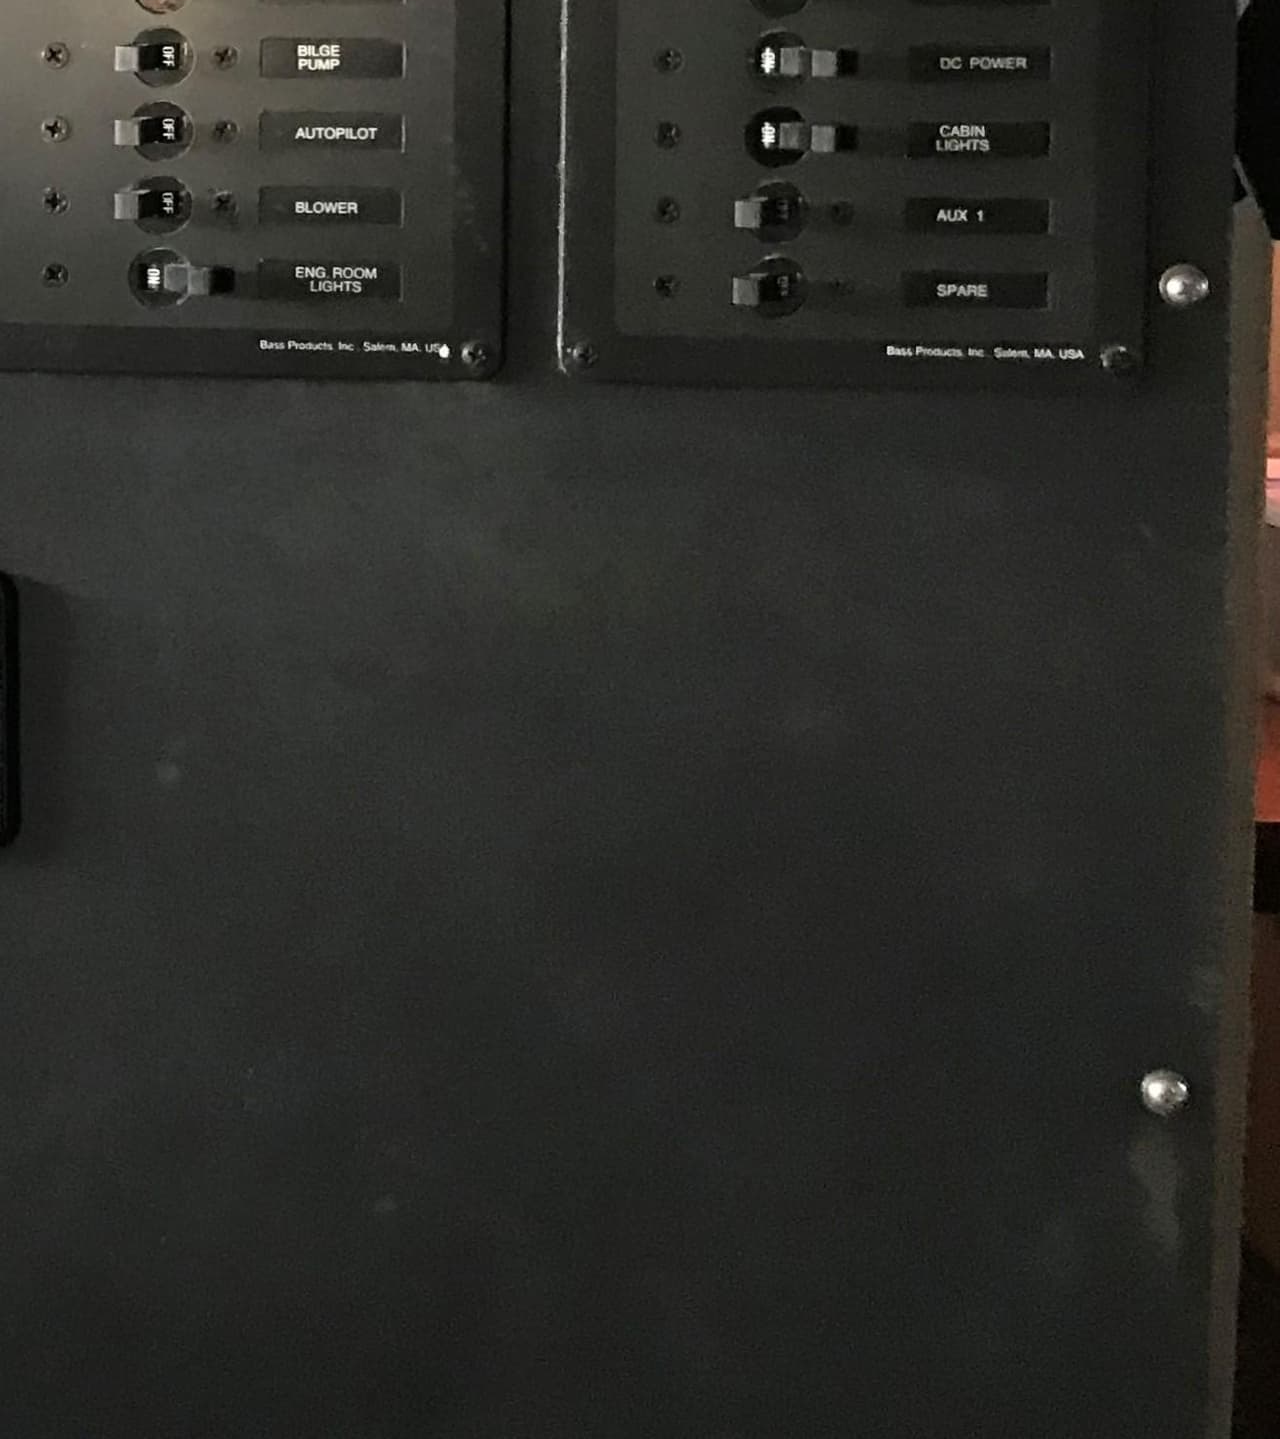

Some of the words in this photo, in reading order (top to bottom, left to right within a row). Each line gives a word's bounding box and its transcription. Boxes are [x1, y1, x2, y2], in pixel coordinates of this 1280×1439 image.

[162, 46, 175, 67] OFF
[298, 45, 340, 57] BILGE
[298, 58, 340, 71] PUMP
[940, 57, 961, 70] DC
[970, 57, 1026, 70] POWER
[163, 118, 175, 140] OFF
[295, 127, 377, 140] AUTOPILOT
[940, 126, 985, 138] CABIN
[936, 139, 989, 152] LIGHTS
[162, 192, 174, 214] OFF
[296, 202, 357, 214] BLOWER
[937, 210, 967, 221] AUX
[977, 210, 983, 221] 1
[333, 268, 377, 280] ROOM
[310, 280, 362, 293] LIGHTS
[937, 285, 987, 296] SPARE
[260, 340, 284, 350] Bass
[425, 343, 449, 357] US
